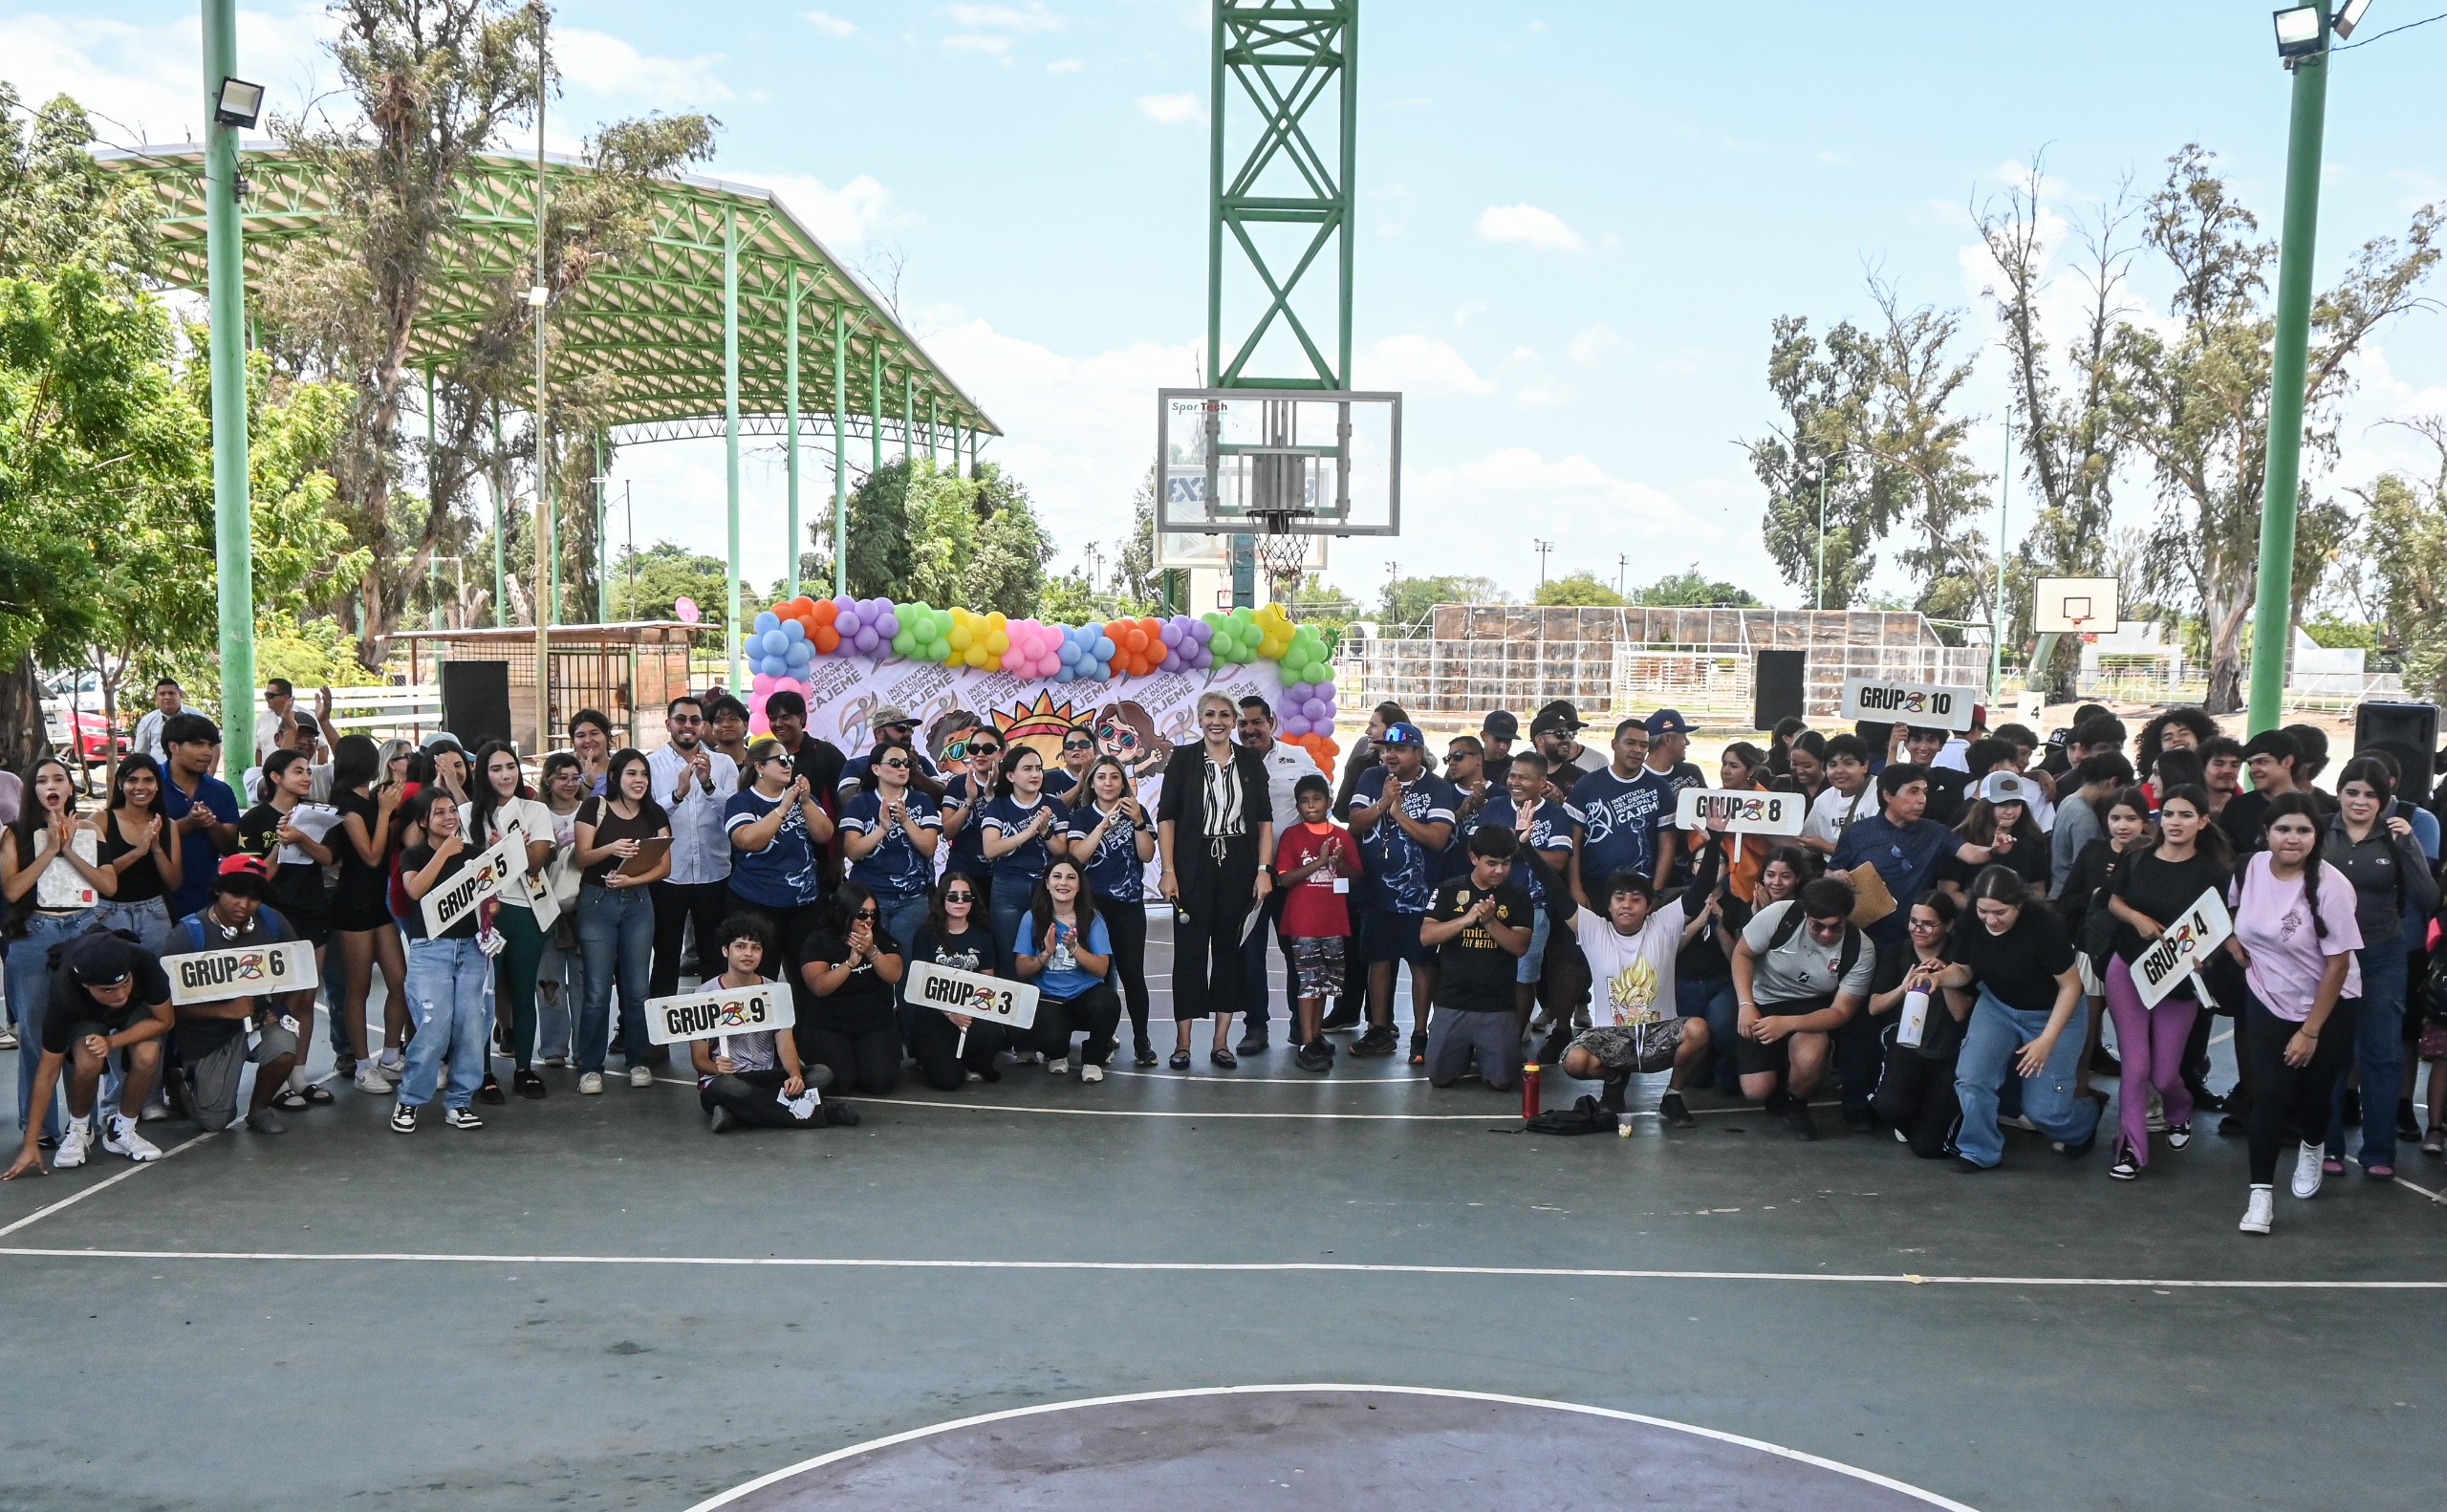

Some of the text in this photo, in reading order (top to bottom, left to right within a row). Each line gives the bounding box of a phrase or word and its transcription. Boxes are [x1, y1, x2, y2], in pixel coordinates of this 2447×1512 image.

[1172, 402, 1228, 415] Spor Tech
[813, 659, 850, 686] DEPORTE
[844, 664, 855, 675] DE
[887, 665, 927, 696] INSTITUTO
[891, 661, 943, 702] DEL DEPORTE
[895, 666, 948, 706] MUNICIPAL DE
[907, 672, 954, 713] AJEME
[970, 670, 1015, 702] DEL DEPOR
[974, 677, 1017, 707] MUNICIPAL
[1068, 679, 1088, 695] DEPO
[1132, 674, 1169, 701] INSTITUTO
[1142, 676, 1189, 709] UNICIPAL DE
[1150, 674, 1183, 697] DEPORTE
[1152, 681, 1195, 718] AJEME
[1931, 693, 1952, 715] 10
[2030, 705, 2041, 720] 4
[1611, 788, 1646, 805] INSTITUTO
[1613, 788, 1658, 810] DEL DEPORTE
[1615, 798, 1652, 815] MUNICIPAL
[1617, 801, 1659, 824] CAJEM
[1768, 799, 1782, 822] 8
[493, 853, 508, 878] 5
[533, 884, 548, 902] 7
[2193, 910, 2209, 937] 4
[1462, 938, 1473, 948] FLY
[269, 950, 286, 976] 6
[749, 997, 765, 1023] 9
[998, 991, 1013, 1015] 3
